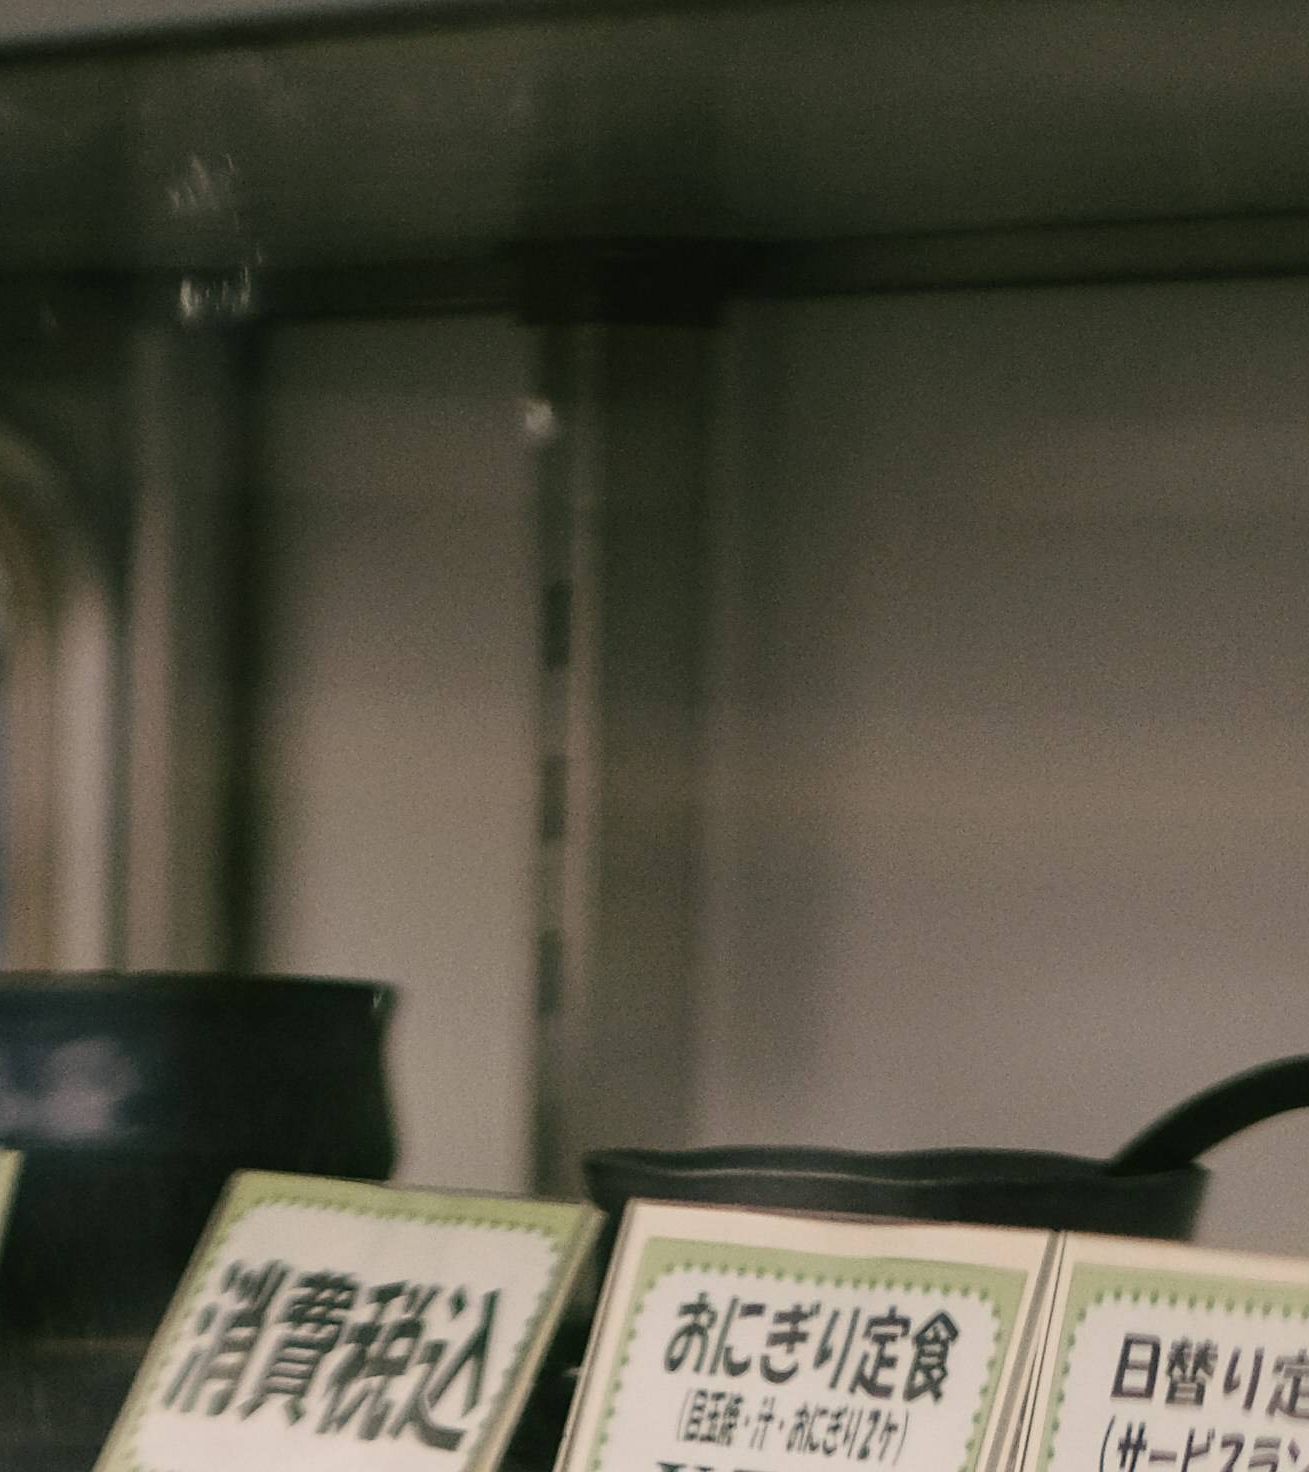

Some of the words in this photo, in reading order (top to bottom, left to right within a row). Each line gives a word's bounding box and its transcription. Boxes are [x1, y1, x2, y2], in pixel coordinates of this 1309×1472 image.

[164, 1259, 502, 1451] 消費税込
[663, 1291, 960, 1405] おにぎり定食
